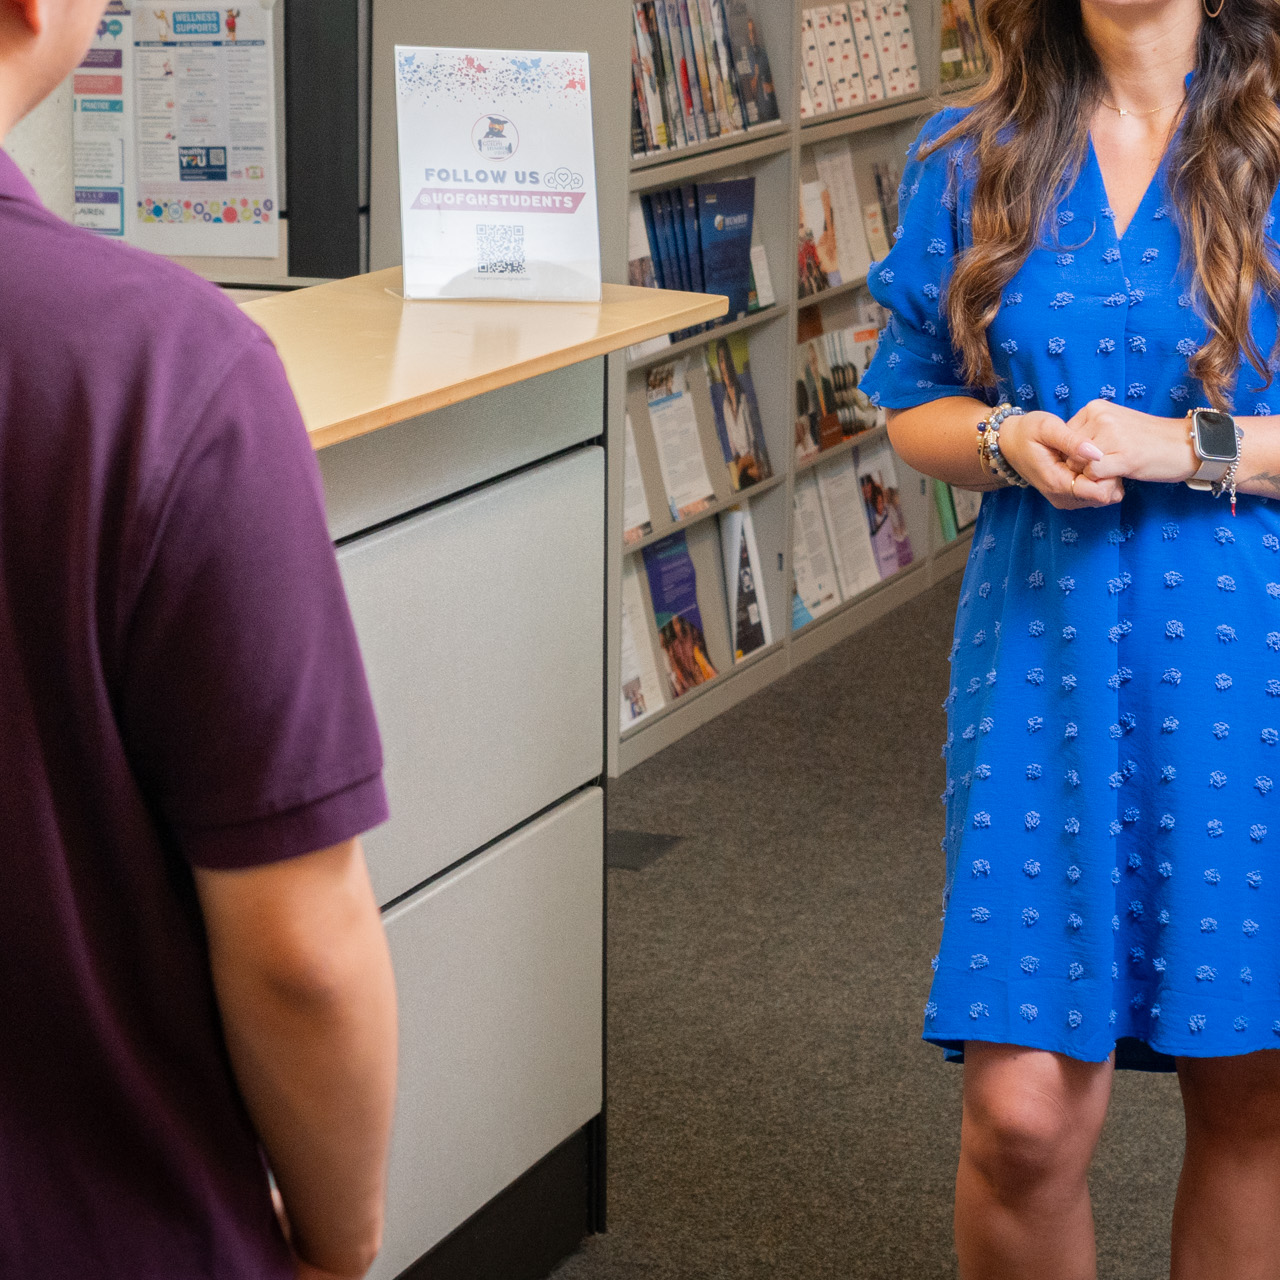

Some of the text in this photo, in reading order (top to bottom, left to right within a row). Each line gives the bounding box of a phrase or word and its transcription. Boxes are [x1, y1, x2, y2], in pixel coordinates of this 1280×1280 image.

[174, 11, 217, 22] WELLNESS
[175, 22, 218, 33] SUPPORTS
[424, 168, 540, 185] FOLLOW US
[418, 187, 574, 209] @UOFGHSTUDENTS
